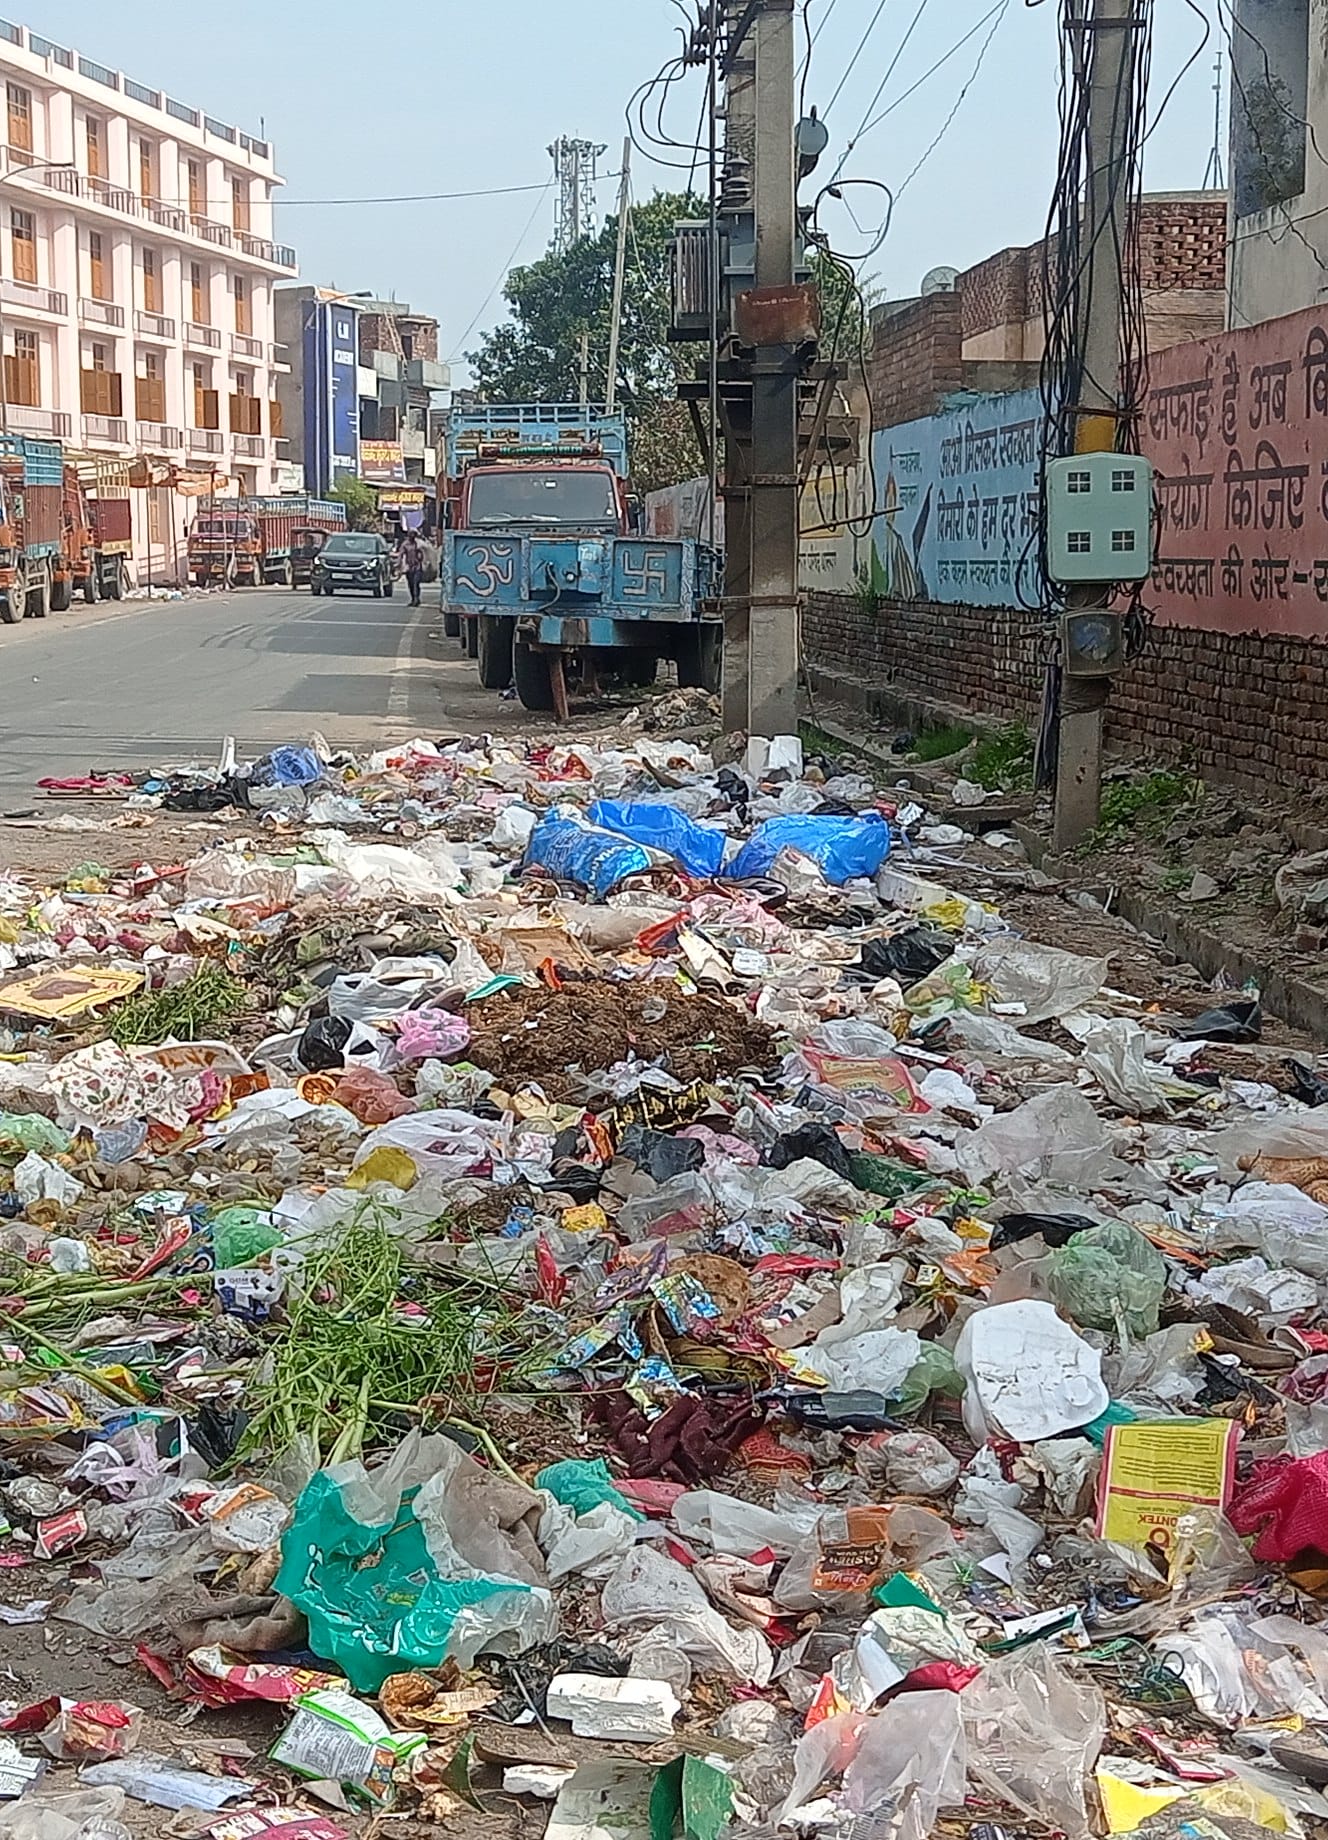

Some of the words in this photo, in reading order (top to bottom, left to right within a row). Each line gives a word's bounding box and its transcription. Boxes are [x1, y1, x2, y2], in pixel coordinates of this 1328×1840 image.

[1149, 355, 1214, 460] सफाई
[1249, 360, 1292, 430] अब
[1220, 543, 1244, 598] की
[1139, 1513, 1180, 1528] ONTEK
